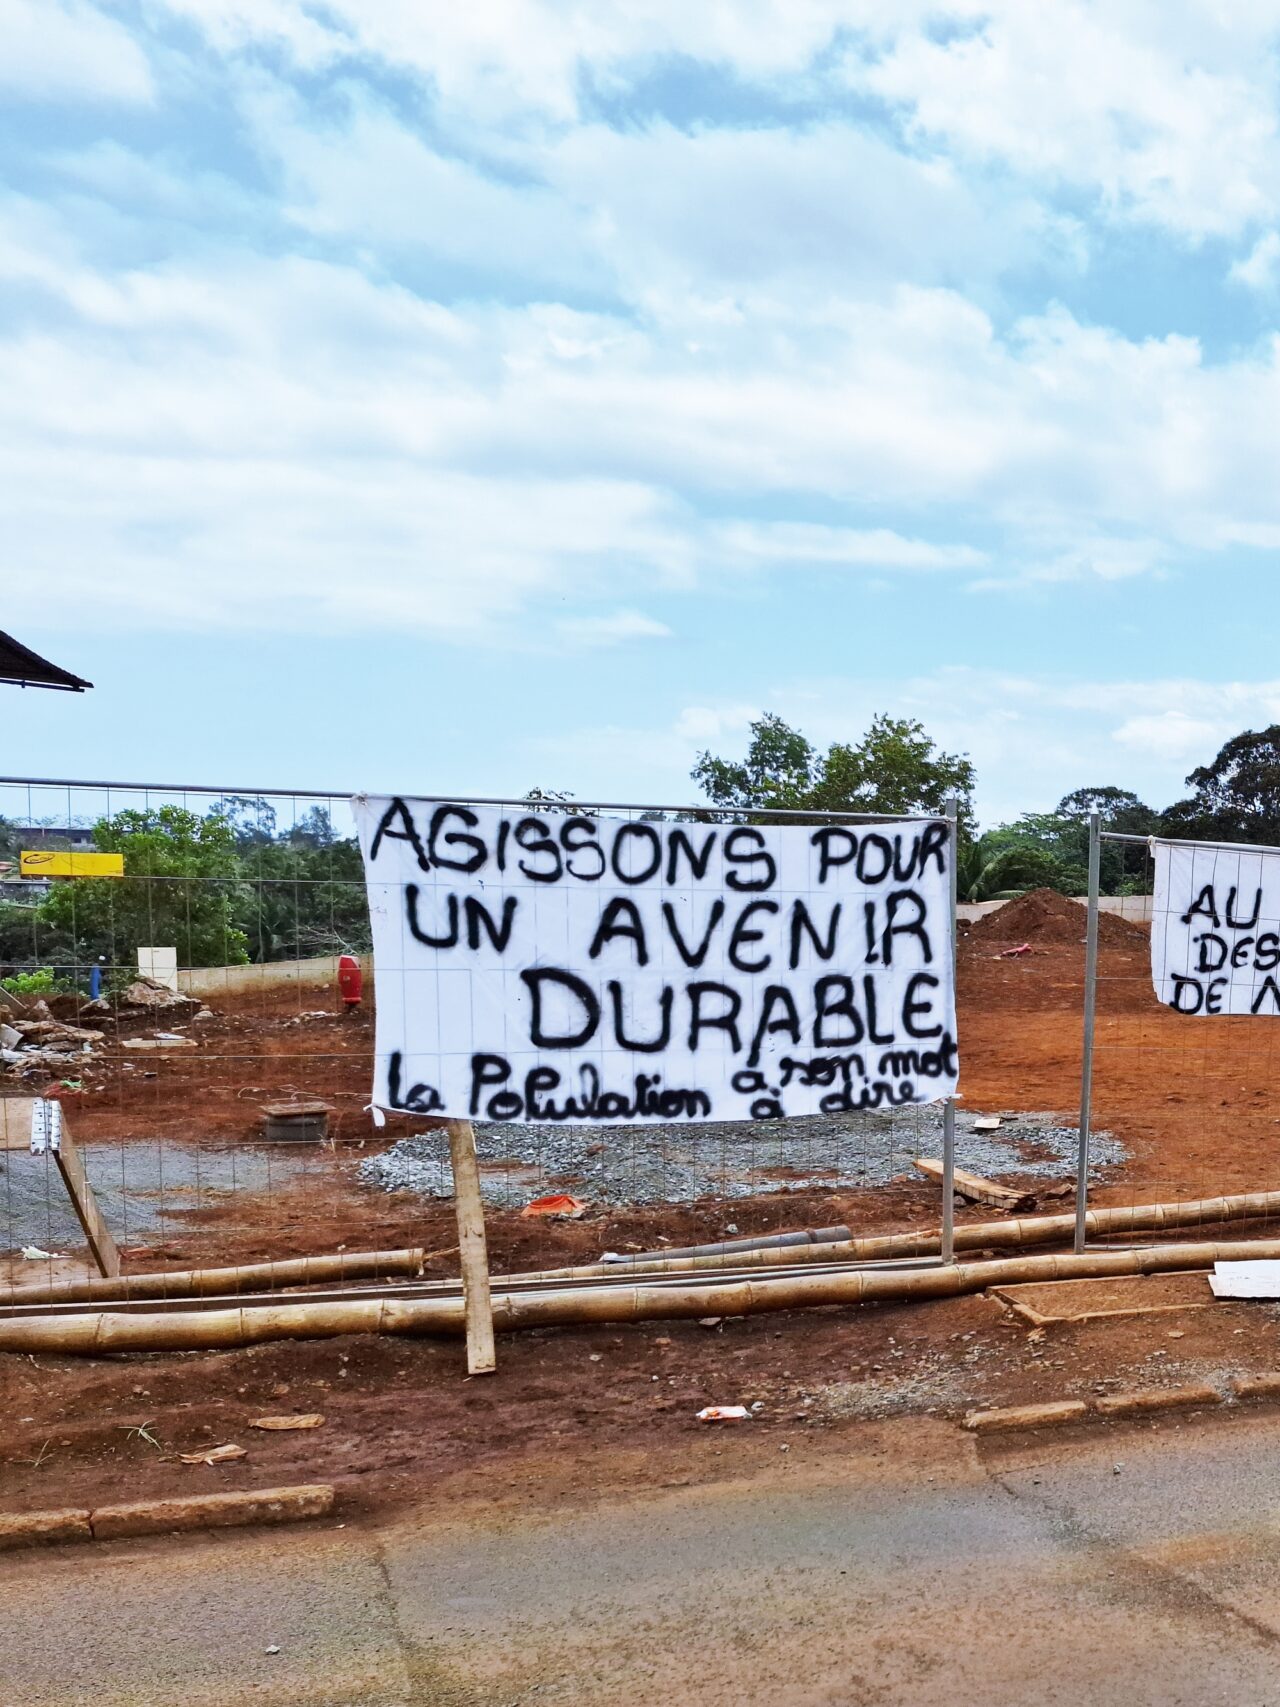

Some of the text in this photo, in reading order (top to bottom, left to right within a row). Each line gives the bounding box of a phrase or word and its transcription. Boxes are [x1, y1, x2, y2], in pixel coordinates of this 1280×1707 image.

[371, 797, 950, 891] AGISSONS POUR
[405, 884, 933, 973] UN AVENIR
[1181, 884, 1263, 930] AU
[520, 967, 943, 1067] DURABLE
[1169, 972, 1228, 1015] DE
[878, 1032, 957, 1079] mot
[820, 1074, 925, 1113] dire
